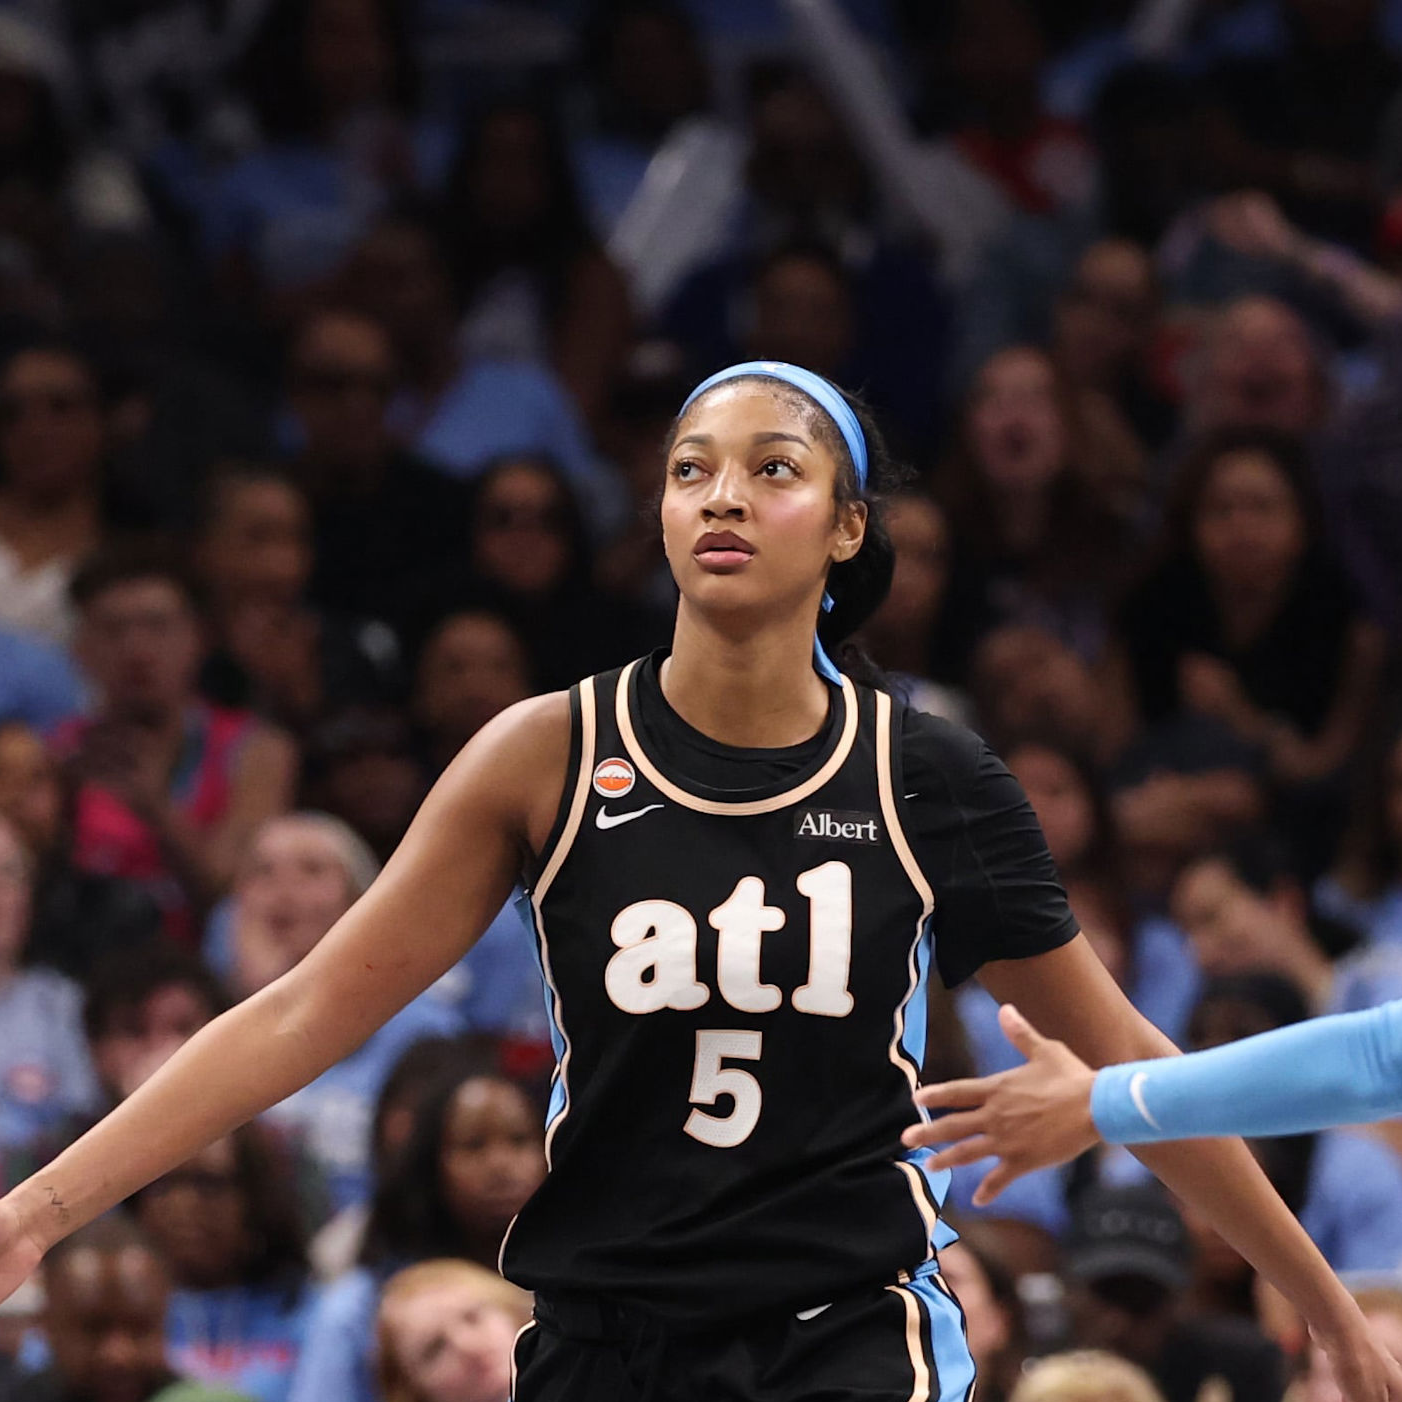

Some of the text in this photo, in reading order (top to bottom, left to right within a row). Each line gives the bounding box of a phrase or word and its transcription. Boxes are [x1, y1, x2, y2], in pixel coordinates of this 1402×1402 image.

[798, 813, 878, 842] Albert
[604, 860, 855, 1018] atl
[682, 1028, 763, 1148] 5
